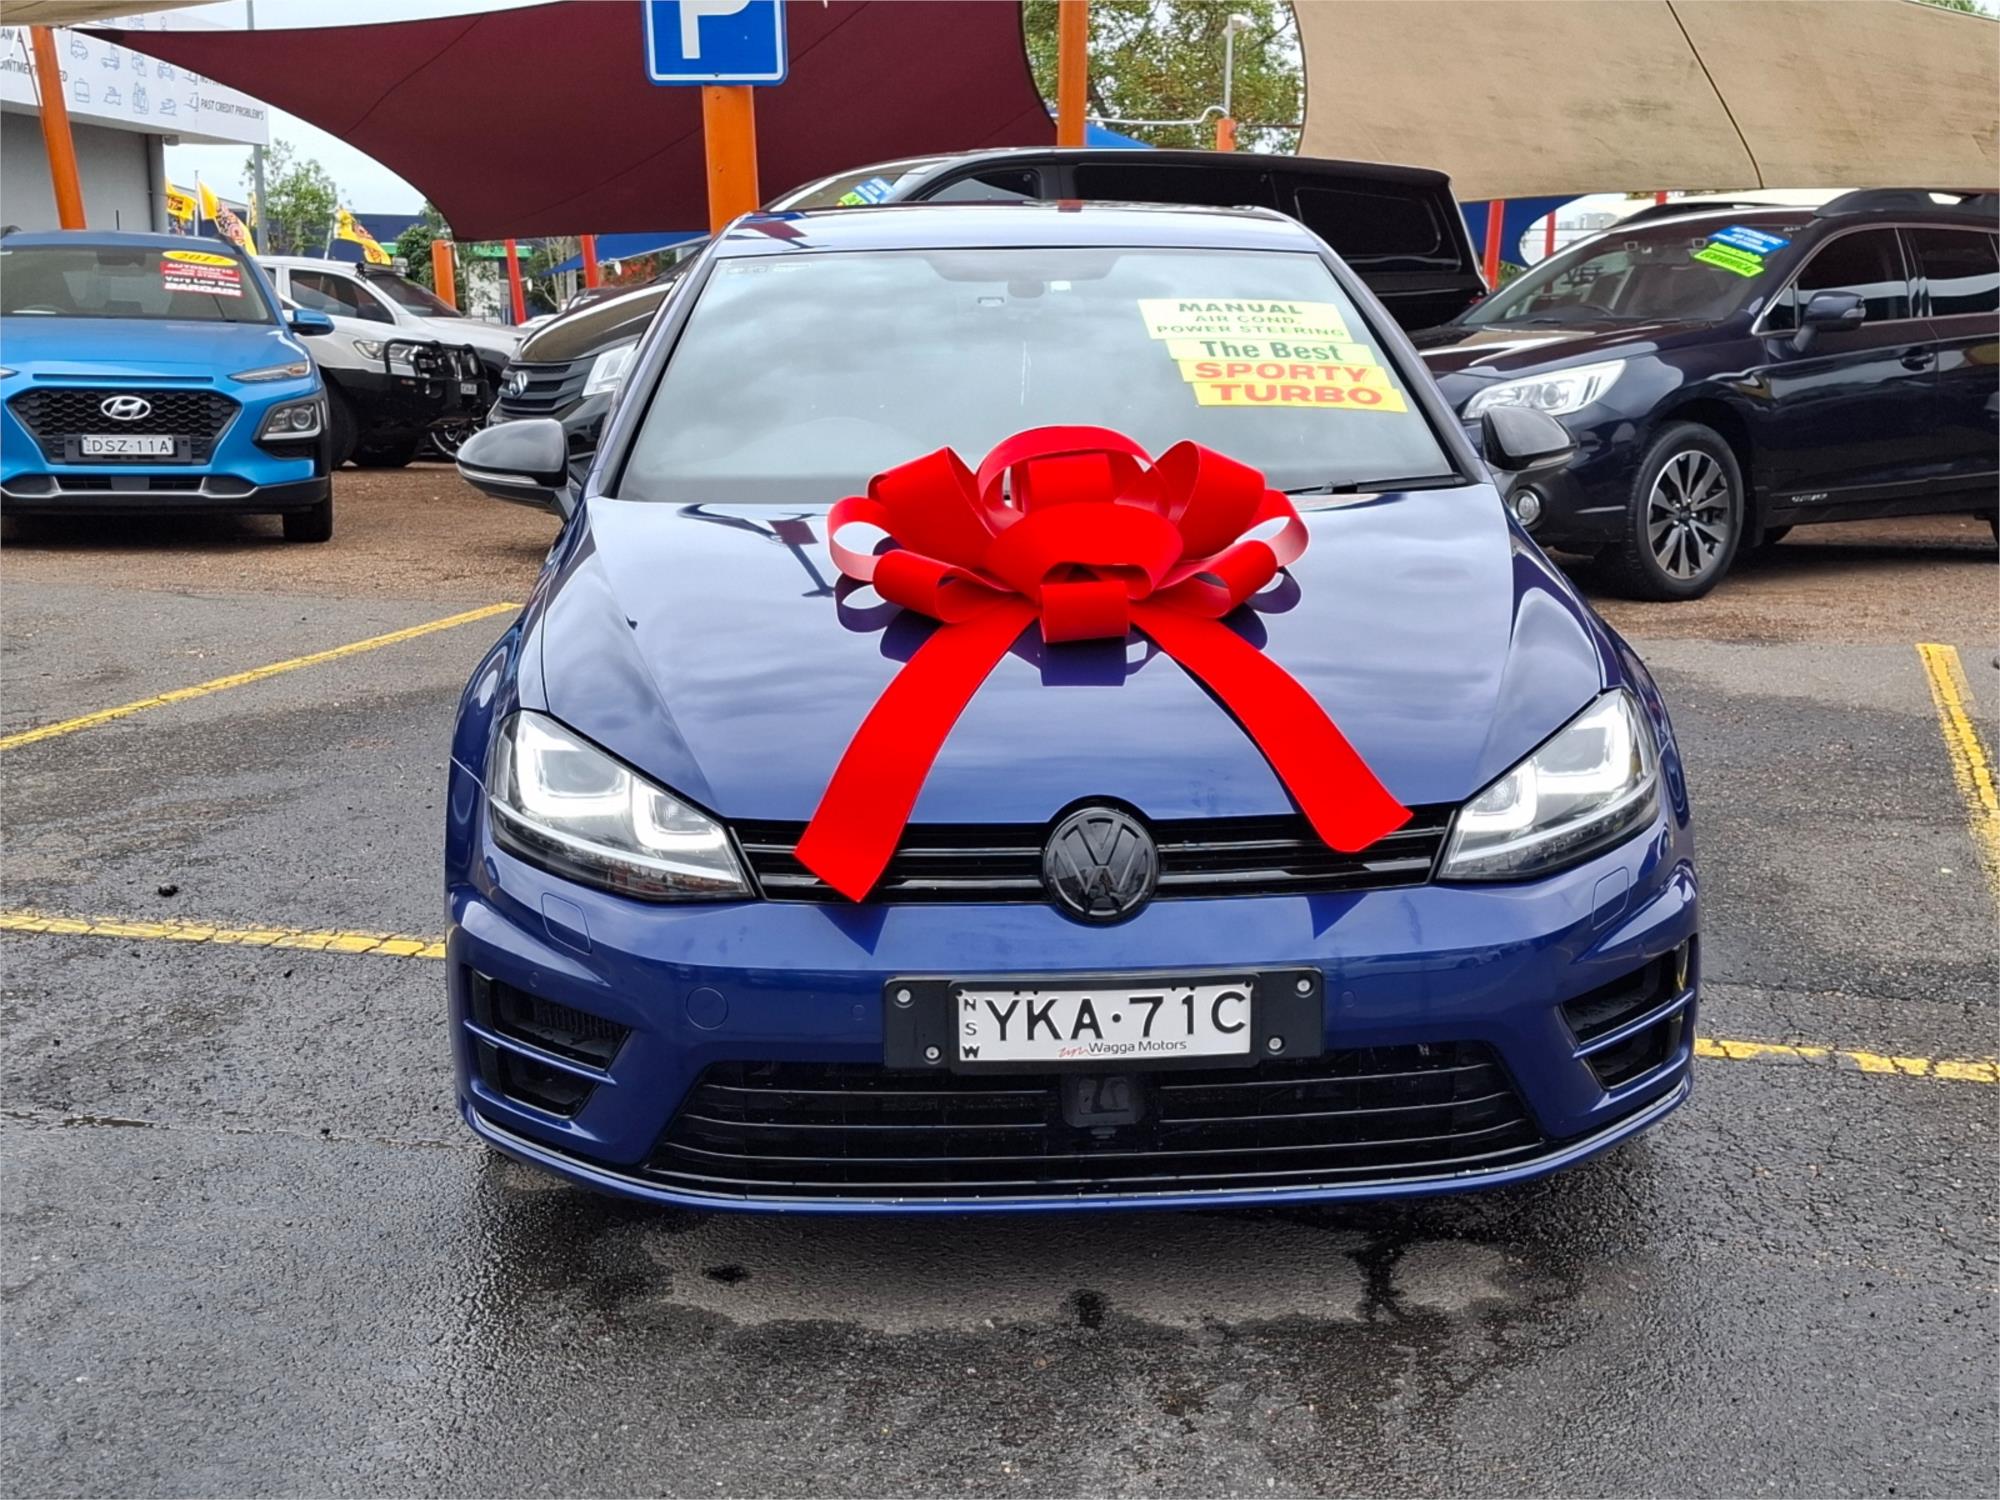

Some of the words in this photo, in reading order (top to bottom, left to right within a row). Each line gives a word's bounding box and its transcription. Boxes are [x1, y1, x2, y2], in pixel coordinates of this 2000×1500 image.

[200, 98, 215, 111] PAST
[215, 101, 235, 114] CREDIT
[1178, 303, 1303, 315] MANUAL
[1195, 315, 1229, 323] AIR
[1156, 325, 1232, 333] POWER
[1240, 325, 1345, 337] STEERING
[1199, 341, 1260, 358] The
[1269, 341, 1344, 361] Best
[1195, 362, 1368, 382] SPORTY
[1210, 384, 1383, 405] TURBO
[1088, 1041, 1135, 1055] Wagga
[1138, 1040, 1188, 1052] Motors
